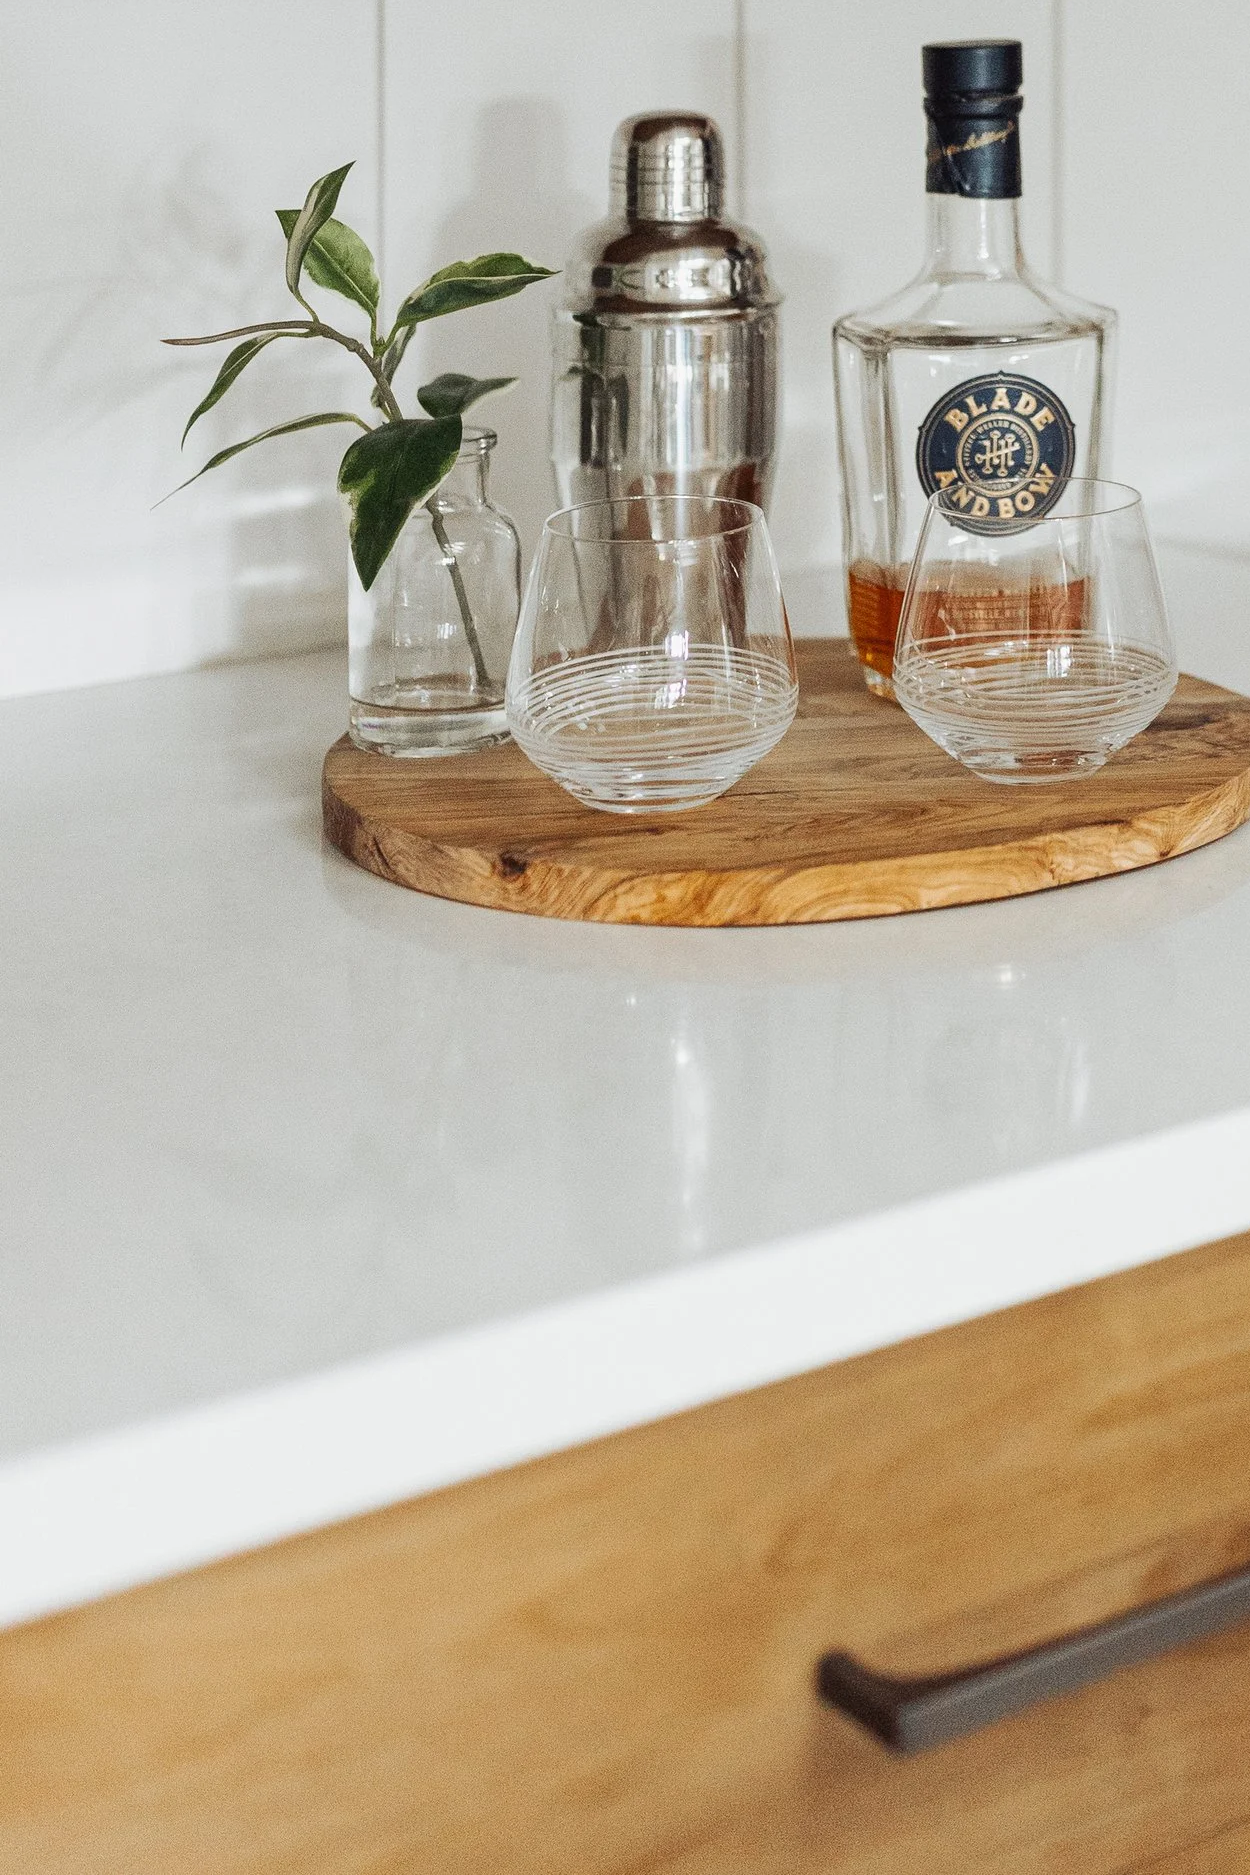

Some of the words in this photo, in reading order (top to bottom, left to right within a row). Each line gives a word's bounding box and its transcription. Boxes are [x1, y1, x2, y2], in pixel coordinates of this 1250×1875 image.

[944, 387, 1056, 433] BLADE
[935, 467, 991, 518] AND
[998, 462, 1057, 519] BOW
